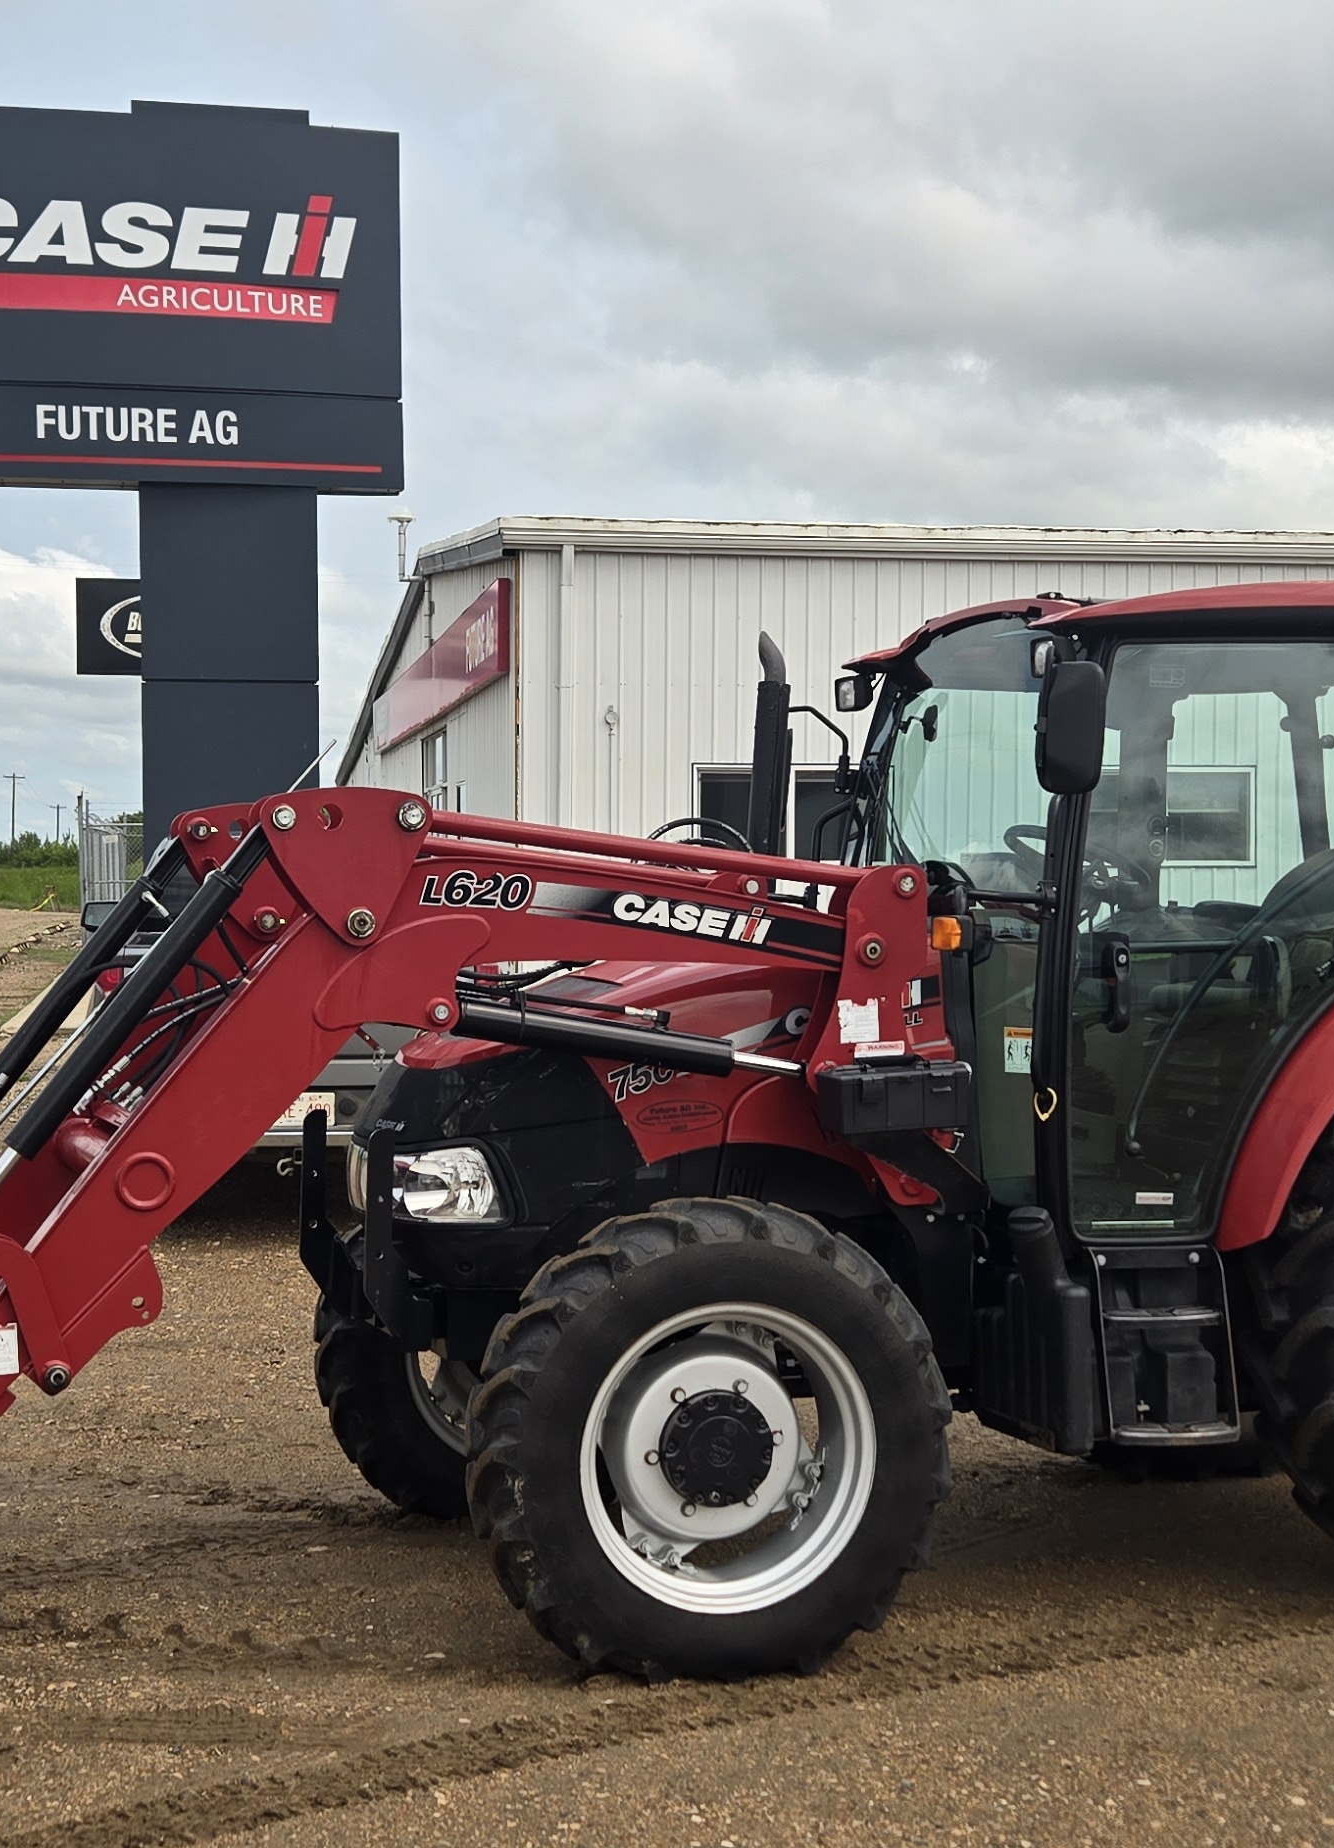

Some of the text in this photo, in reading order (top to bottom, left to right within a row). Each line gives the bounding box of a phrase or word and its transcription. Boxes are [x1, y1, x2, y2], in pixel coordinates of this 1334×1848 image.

[117, 284, 323, 317] AGRICULTURE
[36, 404, 239, 445] FUTURE AG
[419, 869, 533, 911] L620
[613, 893, 731, 938] CASE
[867, 1043, 900, 1051] WARNING
[375, 1118, 397, 1130] CASE
